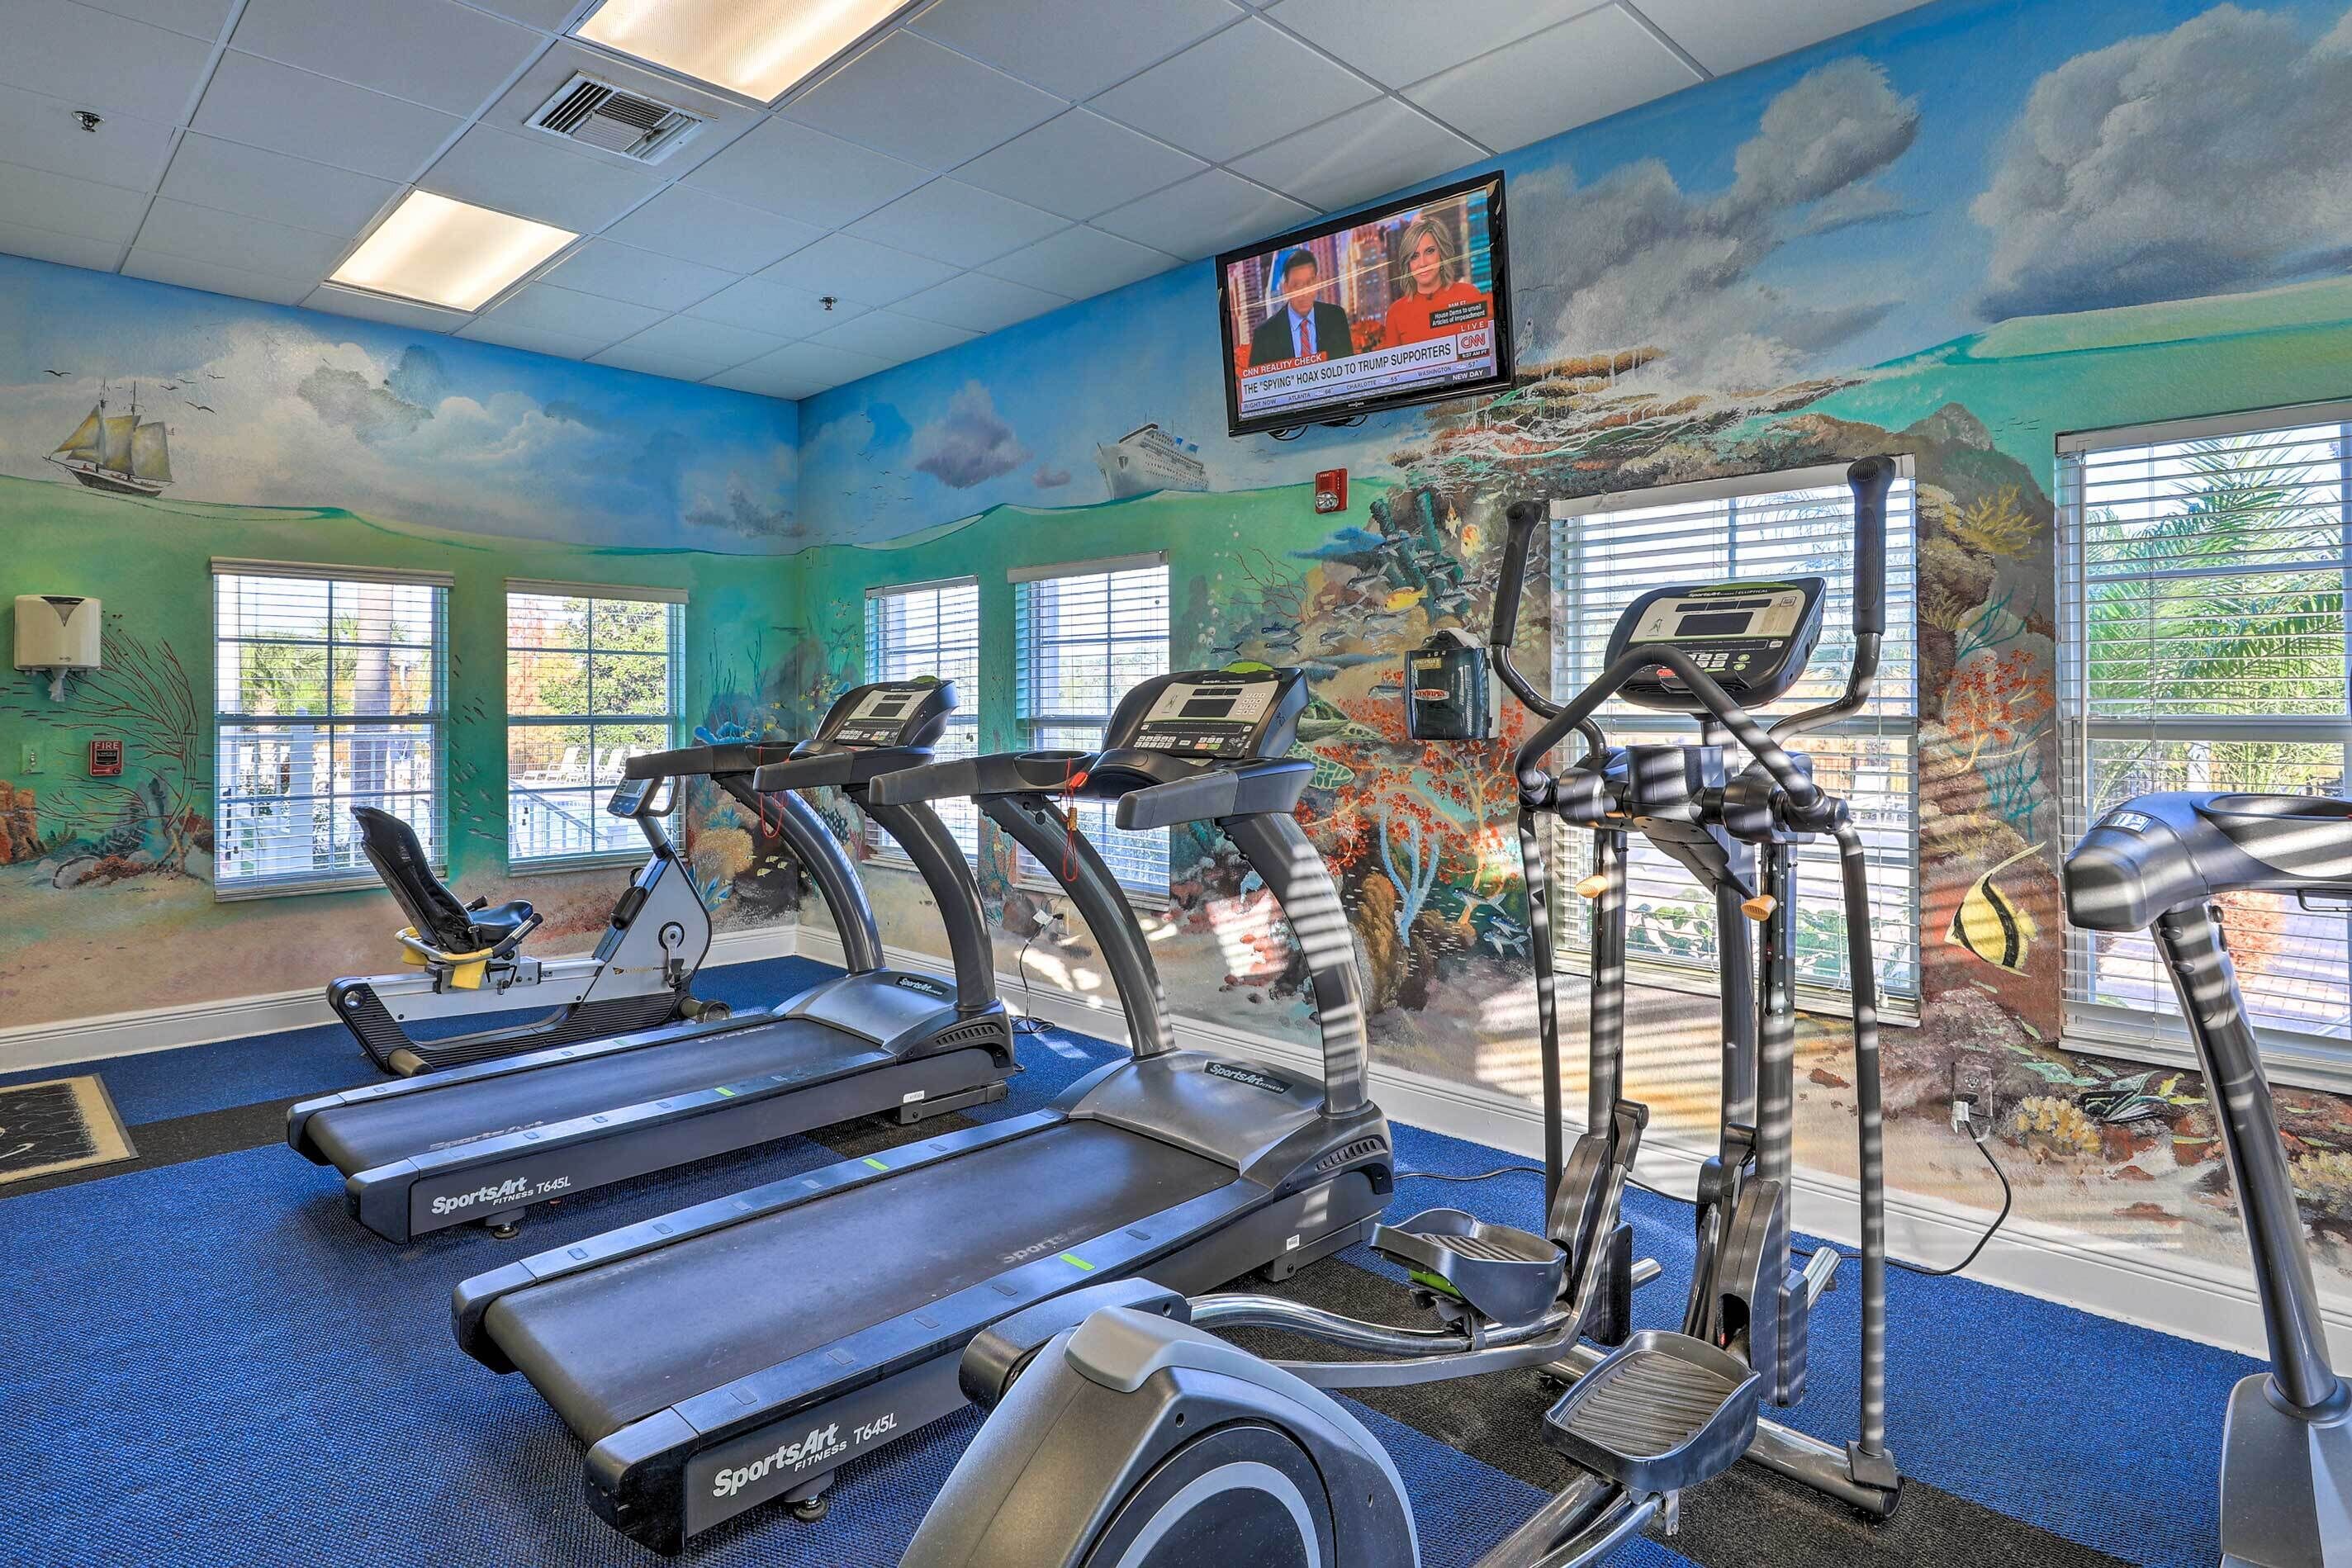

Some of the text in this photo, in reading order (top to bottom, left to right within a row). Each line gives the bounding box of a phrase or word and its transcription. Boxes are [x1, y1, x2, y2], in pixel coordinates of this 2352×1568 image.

[1468, 304, 1482, 312] unveil
[1432, 319, 1449, 327] Articles
[1461, 321, 1485, 331] LIVE
[1461, 333, 1486, 349] CNN
[1242, 353, 1322, 377] CNN REALITY CHECK
[1244, 343, 1451, 395] THE "SPYING" HOAX SOLD TO TRUMP SUPPORTERS
[1452, 369, 1484, 381] NEW DAY
[1244, 402, 1261, 410] RIGHT
[1288, 392, 1311, 401] ATLANTA
[1346, 380, 1377, 391] CHARLOTTE
[1417, 367, 1452, 377] WASHINGTON
[94, 741, 119, 750] FIRE
[899, 978, 932, 992] SportsArt
[1210, 1063, 1284, 1092] SportsArt FITNESS
[431, 1176, 571, 1215] SportsArt T645L
[492, 1189, 533, 1206] FITNESS
[713, 1412, 898, 1497] SportsArt T645L
[794, 1440, 847, 1472] FITNESS
